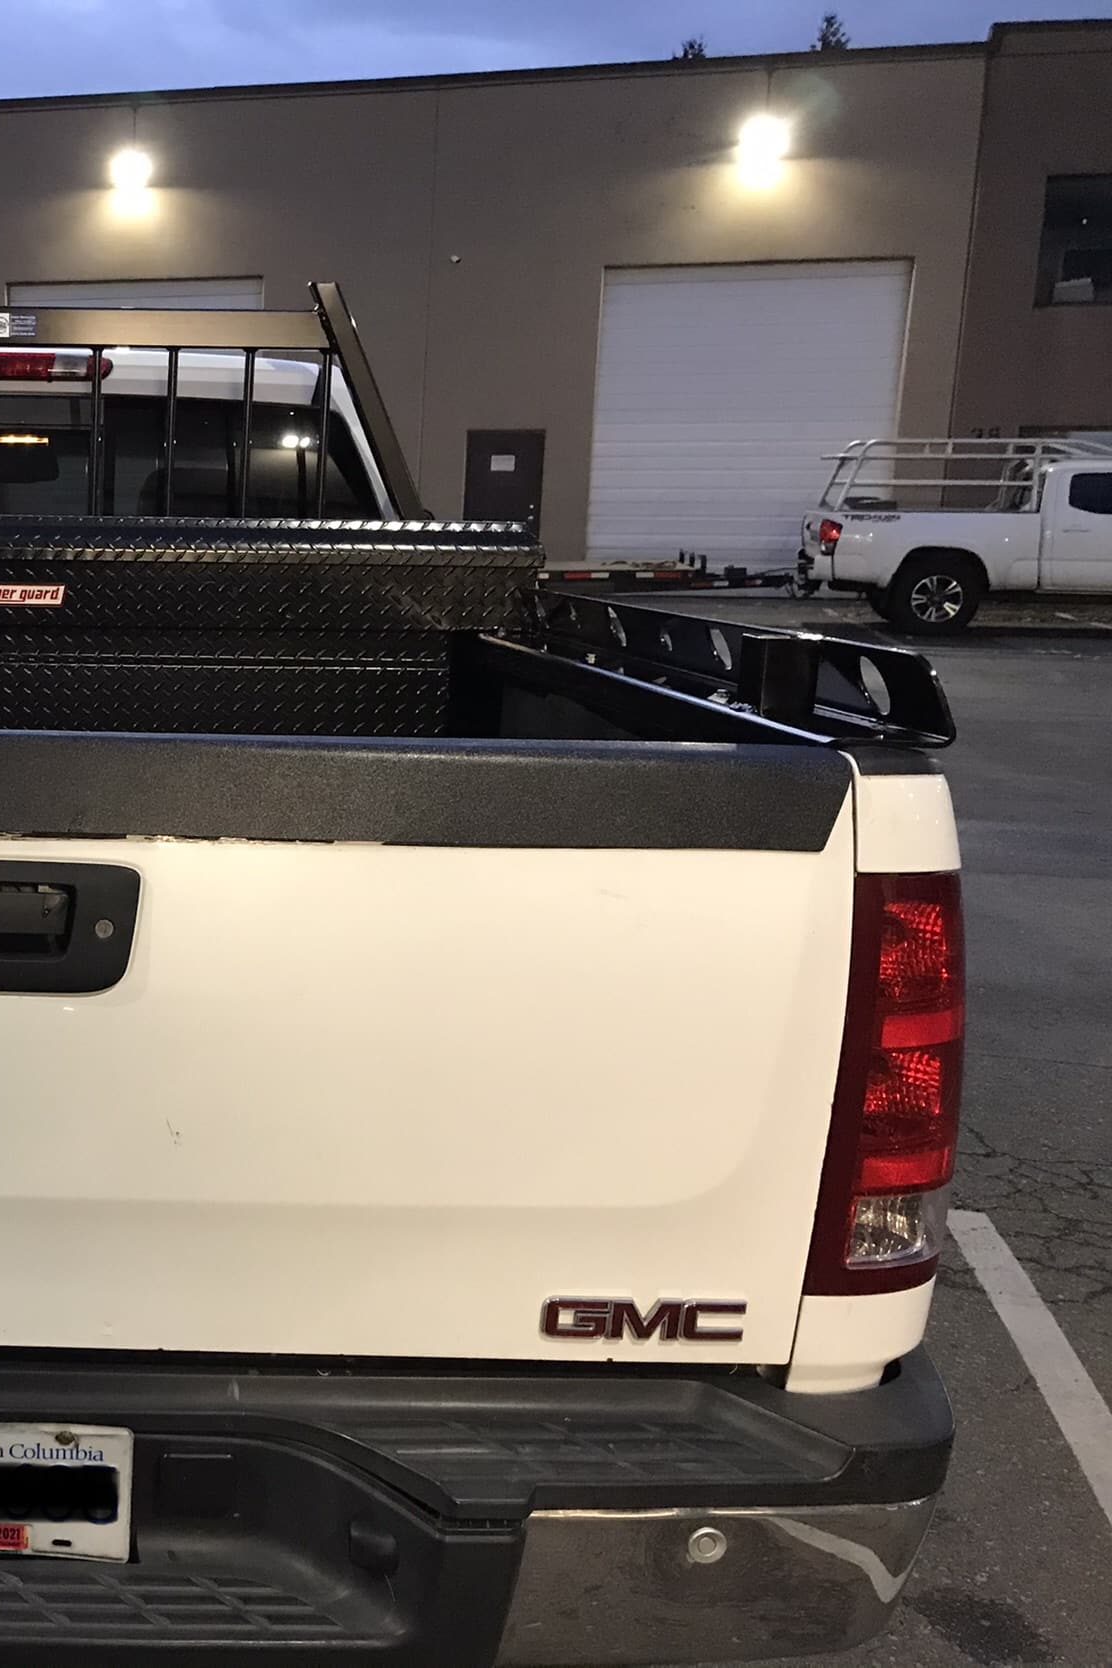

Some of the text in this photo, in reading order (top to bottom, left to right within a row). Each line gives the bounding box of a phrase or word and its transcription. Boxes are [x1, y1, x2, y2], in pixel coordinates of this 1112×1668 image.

[19, 587, 60, 601] guard
[539, 1296, 747, 1342] GMC
[8, 1441, 104, 1462] Columbia
